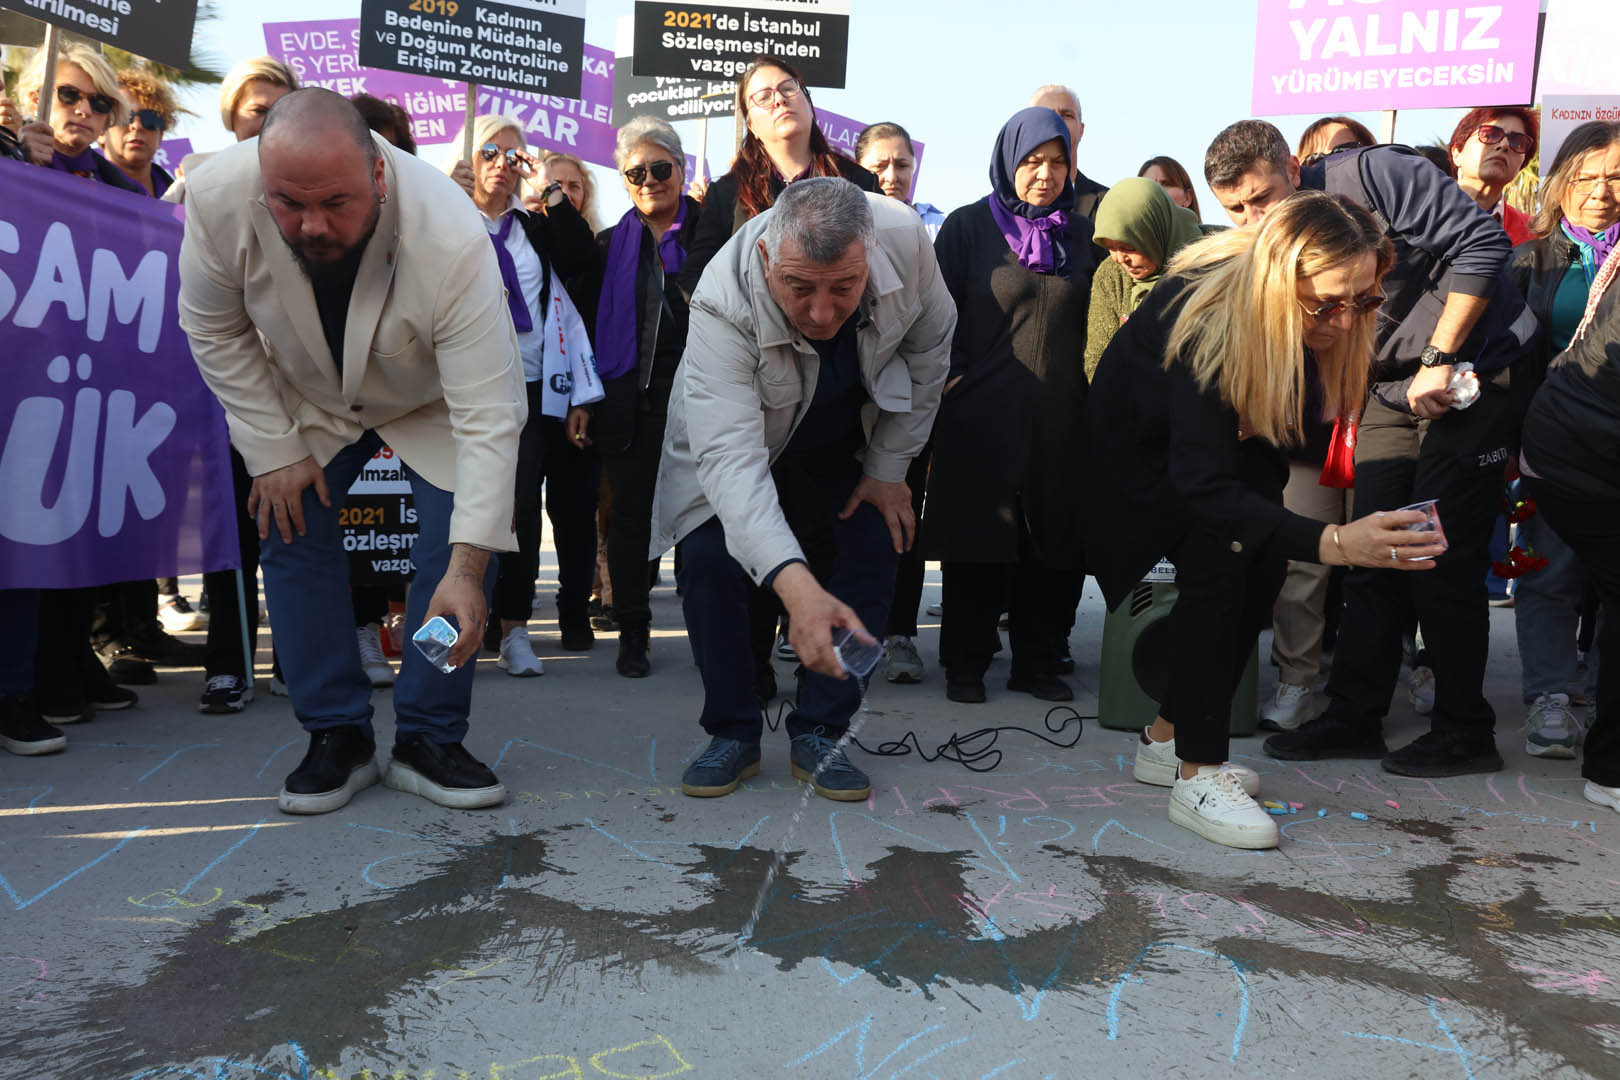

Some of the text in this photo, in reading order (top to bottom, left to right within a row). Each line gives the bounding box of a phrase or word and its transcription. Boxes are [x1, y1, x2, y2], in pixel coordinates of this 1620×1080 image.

[385, 10, 562, 54] Bedenine Müdahale
[475, 7, 542, 32] Kadının
[743, 12, 820, 36] İstanbul
[661, 32, 820, 58] Sözleşmesi'nden
[1290, 6, 1502, 62] YALNIZ
[309, 51, 364, 74] YERİ
[375, 30, 569, 73] ve Doğum Kontrolüne
[397, 50, 547, 88] Erişim Zorlukları
[1271, 58, 1514, 94] YÜRÜMEYECEKSİN
[403, 90, 467, 114] İĞİNE
[627, 84, 701, 108] çocuklar
[338, 507, 385, 525] 2021
